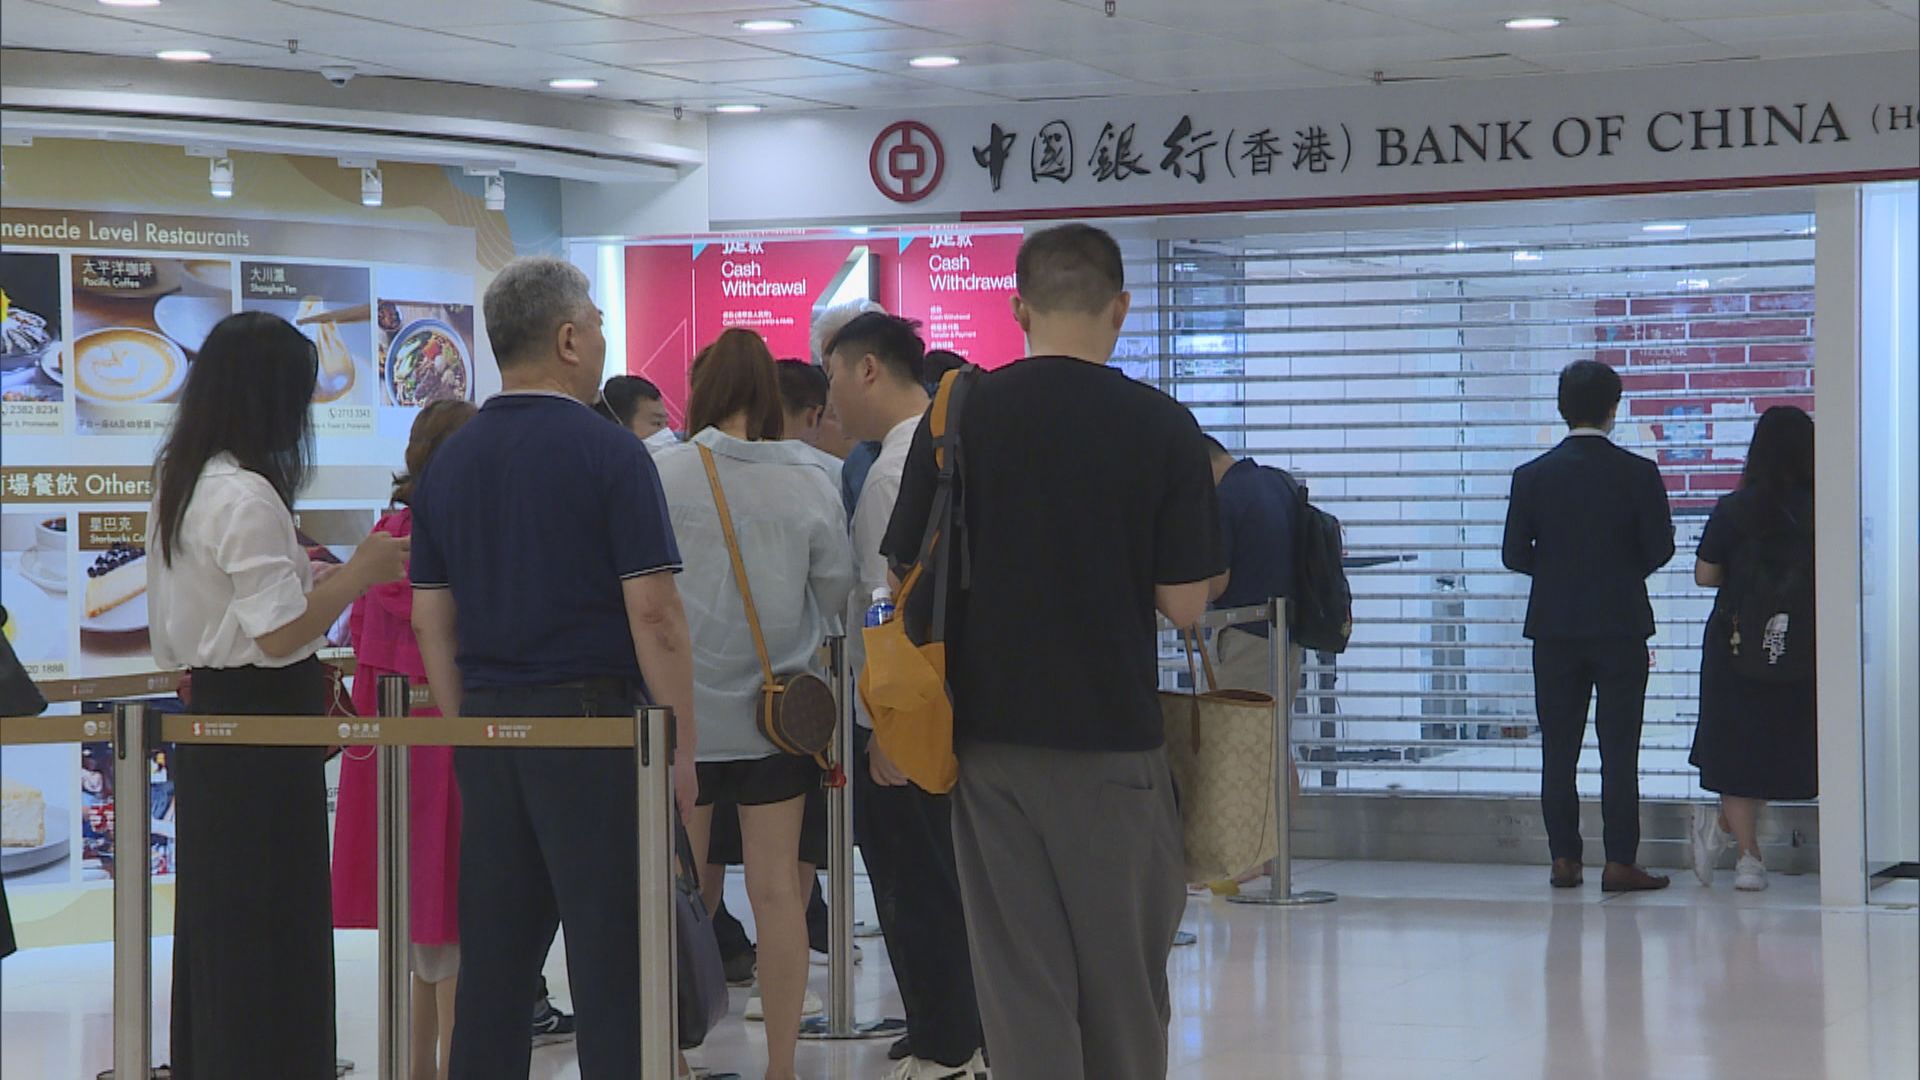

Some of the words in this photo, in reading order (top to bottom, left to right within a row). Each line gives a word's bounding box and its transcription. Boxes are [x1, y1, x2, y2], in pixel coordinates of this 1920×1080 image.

[1376, 120, 1533, 167] BANK
[1552, 114, 1625, 160] OF
[1647, 101, 1850, 153] CHINA
[89, 219, 139, 243] Level
[146, 222, 250, 247] Restaurants
[82, 259, 153, 277] 太平洋咖啡
[721, 259, 762, 278] Cash
[928, 253, 970, 272] Cash
[82, 277, 111, 287] Pacific
[112, 277, 140, 288] Coffee
[250, 282, 283, 295] Shanghai
[721, 278, 807, 297] Withdrawal
[929, 271, 1017, 292] Withdrawal
[1, 472, 79, 496] 場餐飲
[85, 472, 153, 495] Others
[89, 517, 133, 532] 星巴克
